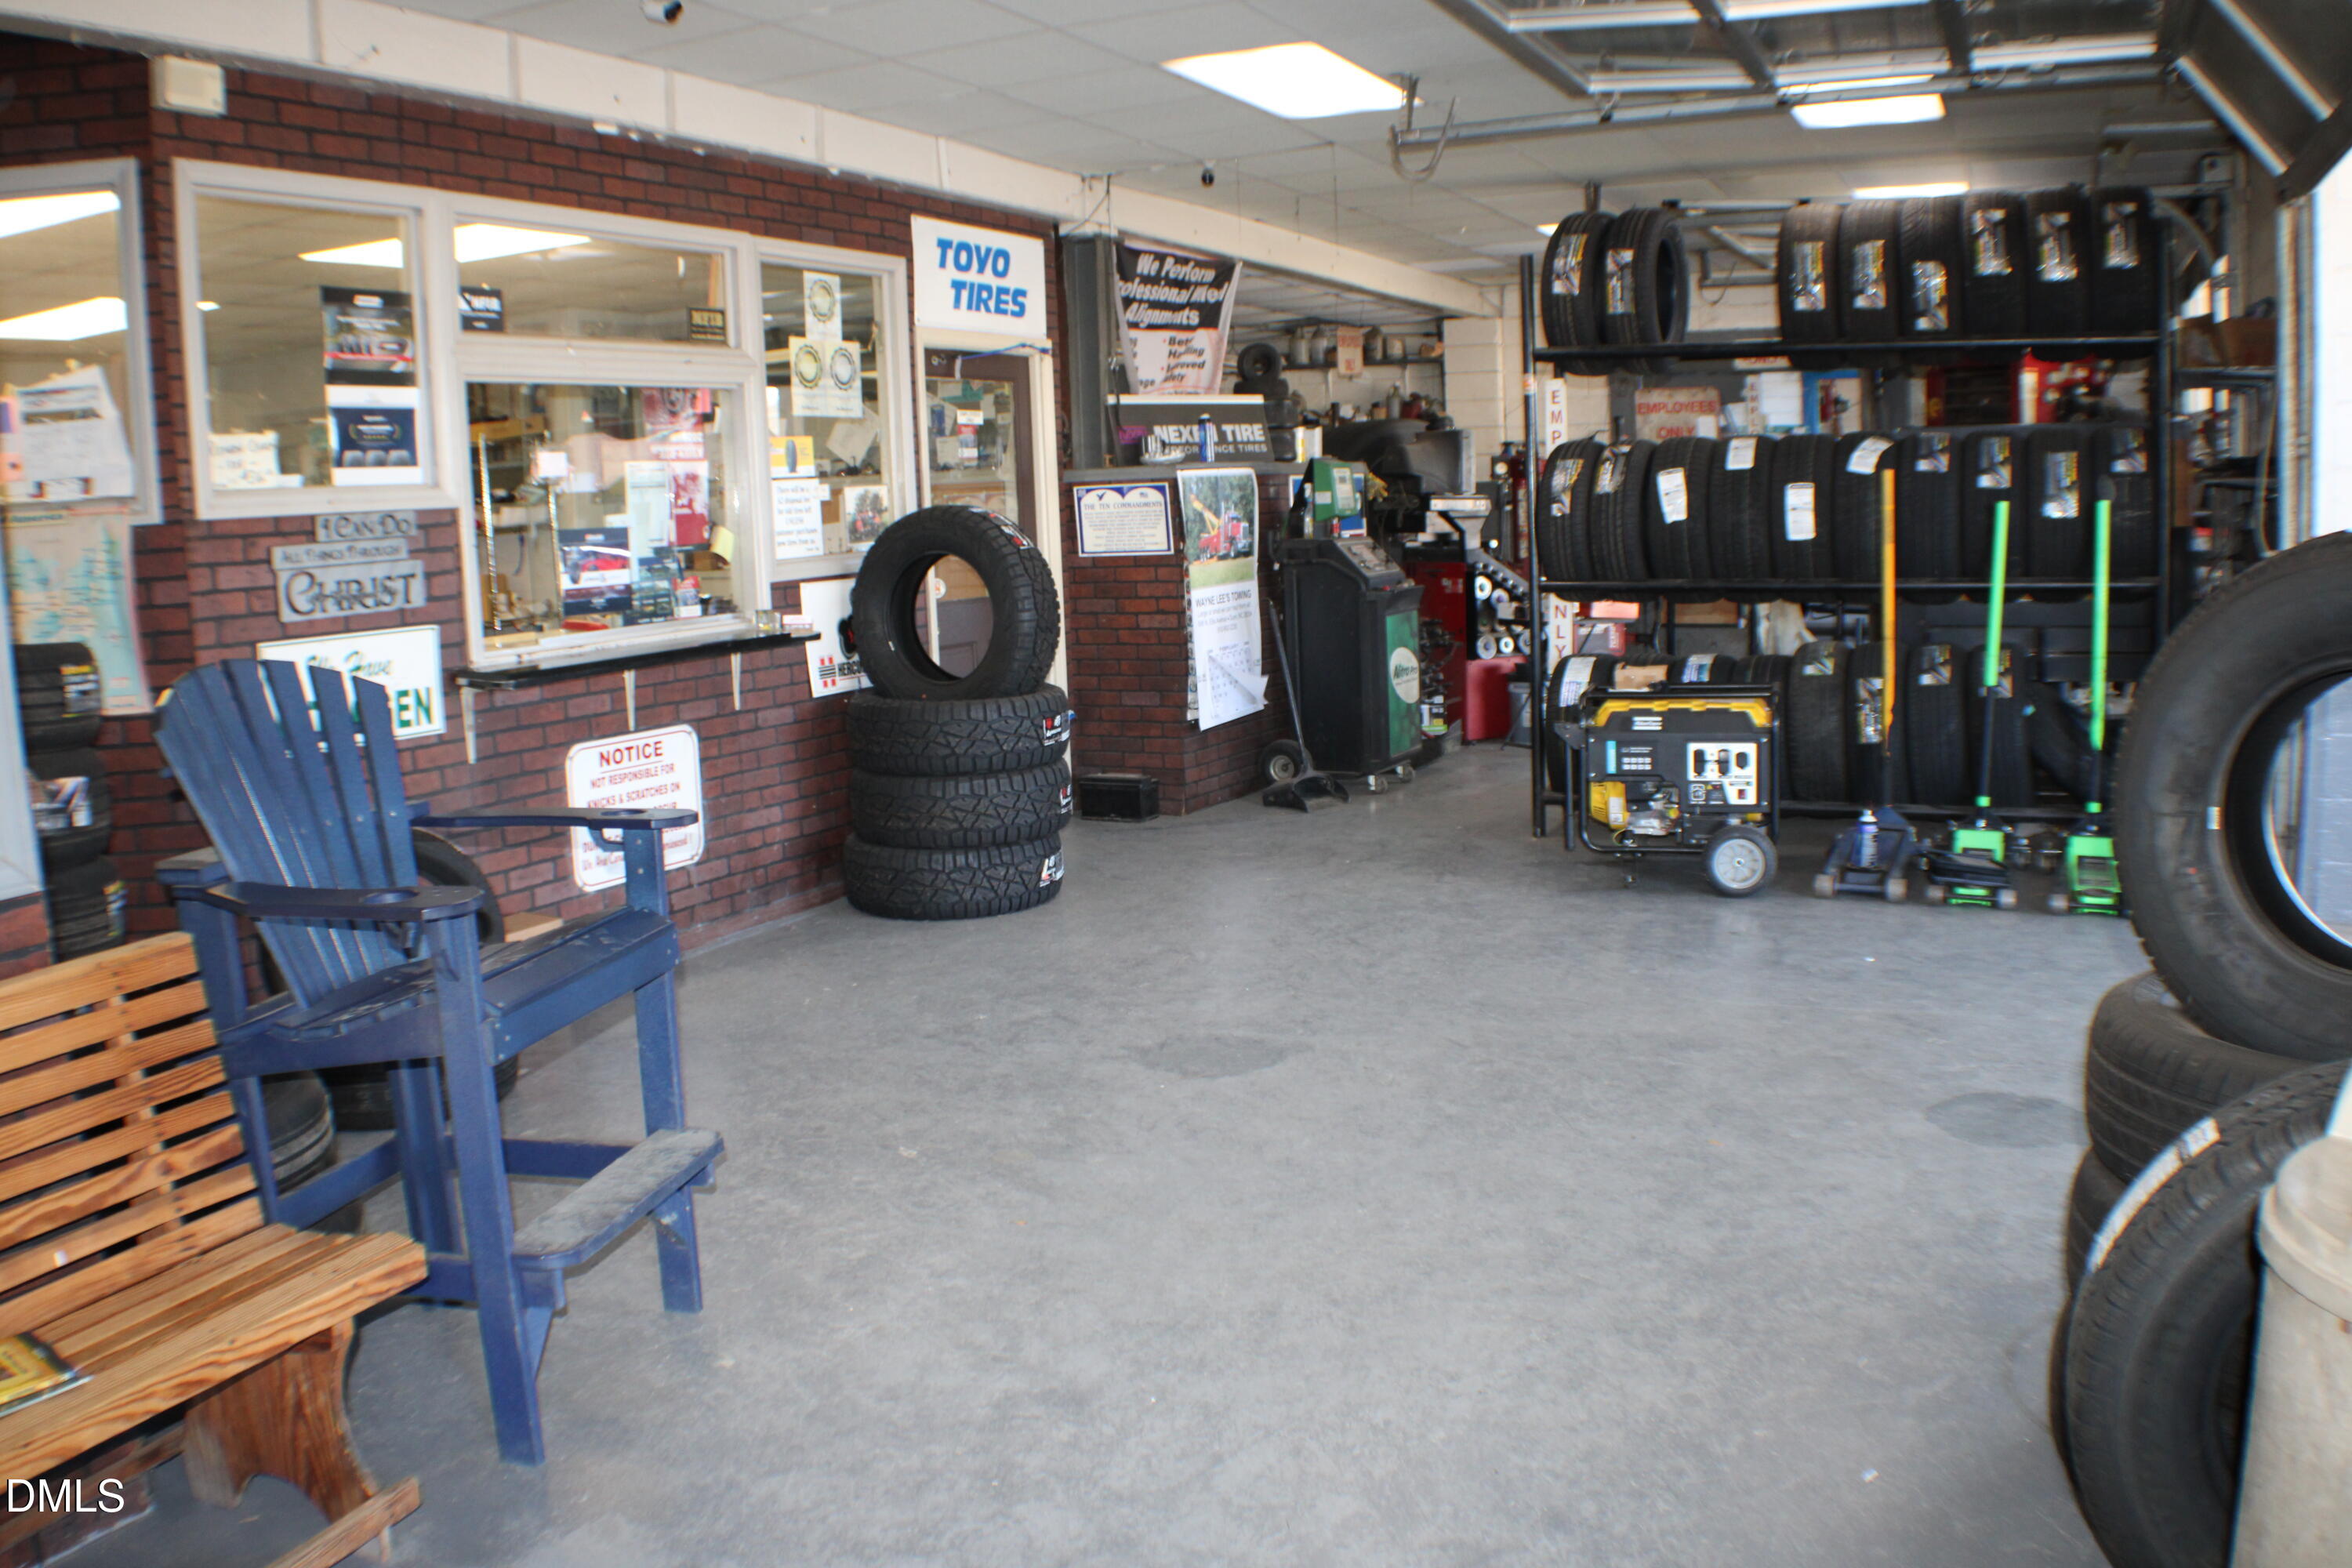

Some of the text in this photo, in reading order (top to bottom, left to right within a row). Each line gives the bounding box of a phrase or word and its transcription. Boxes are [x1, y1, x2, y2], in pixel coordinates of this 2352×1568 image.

[937, 237, 1011, 278] TOYO
[1137, 252, 1216, 283] We Perform
[950, 278, 1029, 318] TIRES
[1119, 276, 1194, 305] rofessional
[1637, 401, 1717, 416] EMPLOYEES
[1221, 423, 1265, 443] TIRE
[1238, 443, 1267, 453] TIRES
[1113, 501, 1163, 510] COMMANDMENTS
[285, 571, 417, 616] CHRIST
[1196, 595, 1216, 608] WAYNE
[1231, 590, 1252, 602] TOWING
[599, 740, 664, 768] NOTICE
[590, 763, 676, 789] NOT RESPONSIBLE FOR
[626, 784, 668, 802] SCRATCHES
[670, 781, 681, 793] ON
